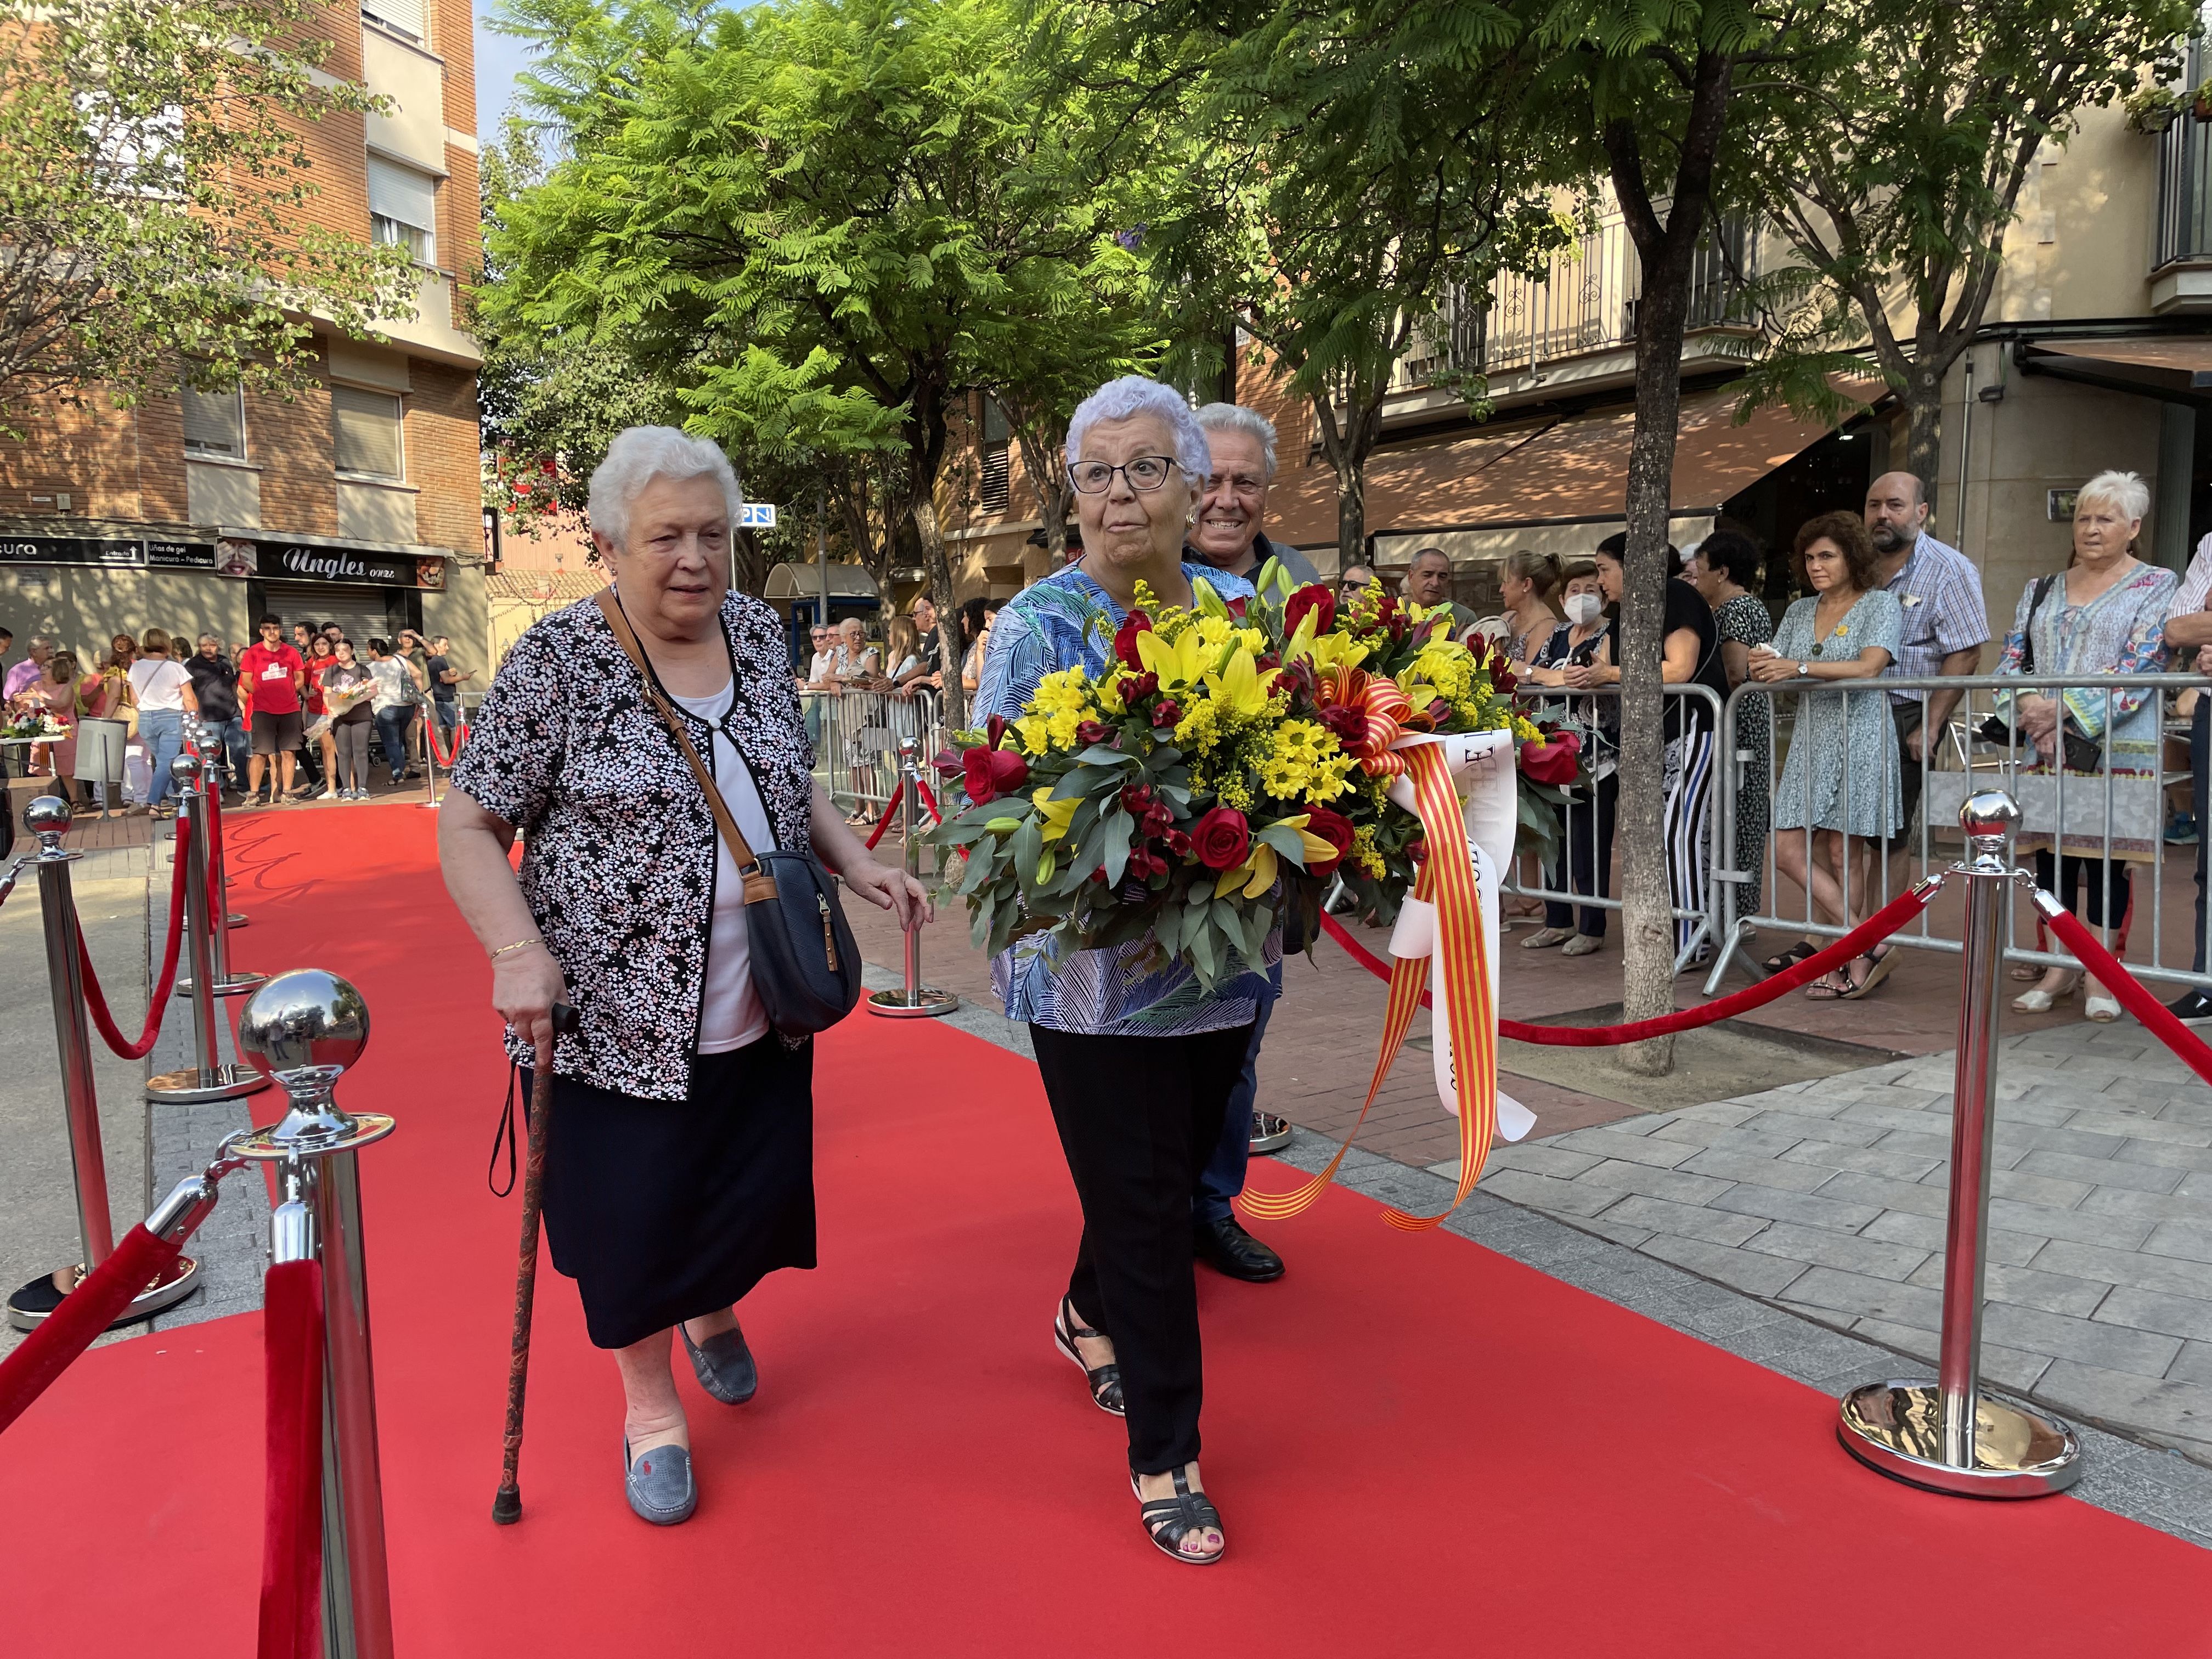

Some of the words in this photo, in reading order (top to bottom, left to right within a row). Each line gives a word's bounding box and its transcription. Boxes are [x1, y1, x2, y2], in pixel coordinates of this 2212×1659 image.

[176, 546, 186, 554] gel
[149, 554, 179, 562] Manicura
[283, 548, 367, 579] Ungles
